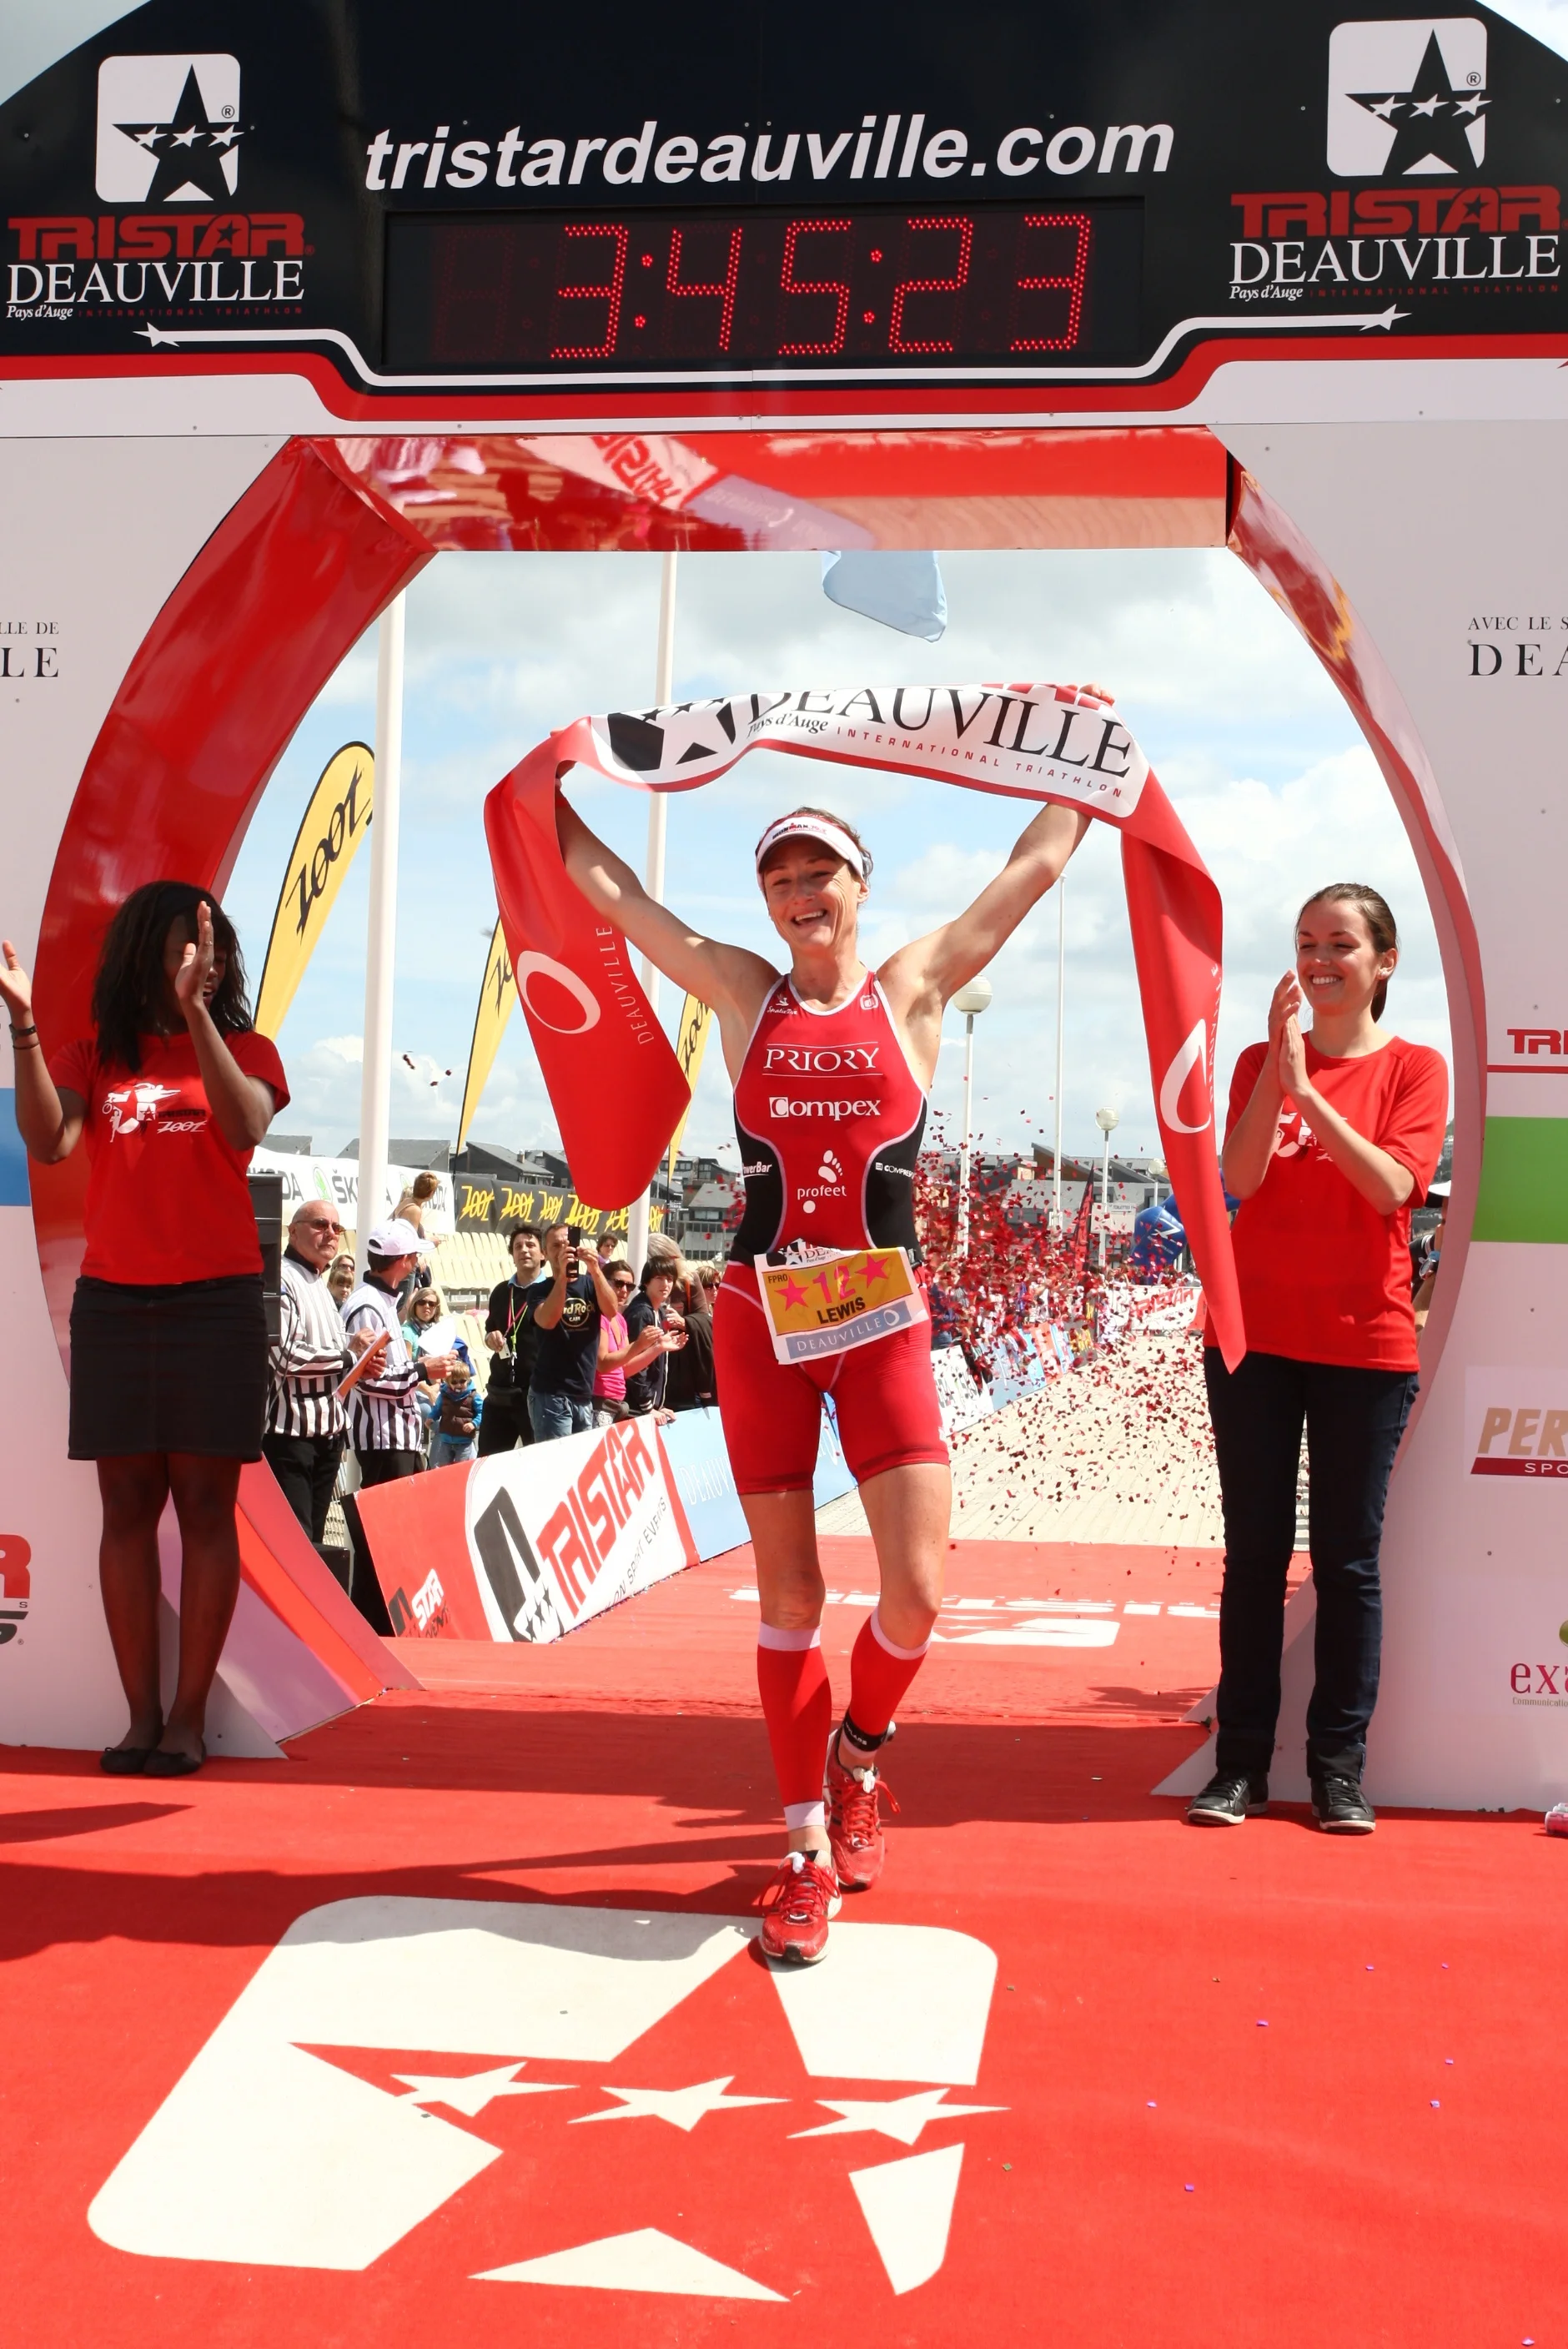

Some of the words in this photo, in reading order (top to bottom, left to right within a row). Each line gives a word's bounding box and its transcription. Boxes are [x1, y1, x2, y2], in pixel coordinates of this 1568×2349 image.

[364, 114, 1174, 191] tristardeauville.com
[1230, 185, 1562, 239] TRISTAR
[8, 213, 305, 260] TRISTAR
[1229, 235, 1561, 284] DEAUVILLE
[6, 260, 305, 304] DEAUVILLE
[550, 214, 1091, 359] 3:45:23
[1229, 285, 1259, 301] Pays
[1309, 286, 1450, 298] INTERNATIONAL
[1462, 284, 1560, 294] TRIATHLON
[6, 305, 34, 320] Pays
[78, 307, 204, 318] INTERNATIONAL
[216, 306, 303, 316] TRIATHLON
[36, 621, 60, 635] DE
[1468, 616, 1519, 631] AVEC
[1528, 616, 1551, 631] LE
[747, 687, 1132, 778] DEAUVILLE
[837, 726, 1000, 767] INTERNATIONAL
[1015, 762, 1123, 799] TRIATHLON
[596, 925, 655, 1044] DEAUVILLE
[763, 1048, 879, 1072] PRIORY
[769, 1096, 881, 1121] Compex
[797, 1185, 847, 1200] profeet
[768, 1273, 788, 1285] FPRO
[812, 1265, 856, 1304] 12
[817, 1296, 866, 1325] LEWIS
[797, 1317, 881, 1351] DEAUVILLE
[535, 1418, 656, 1619] TRISTAR
